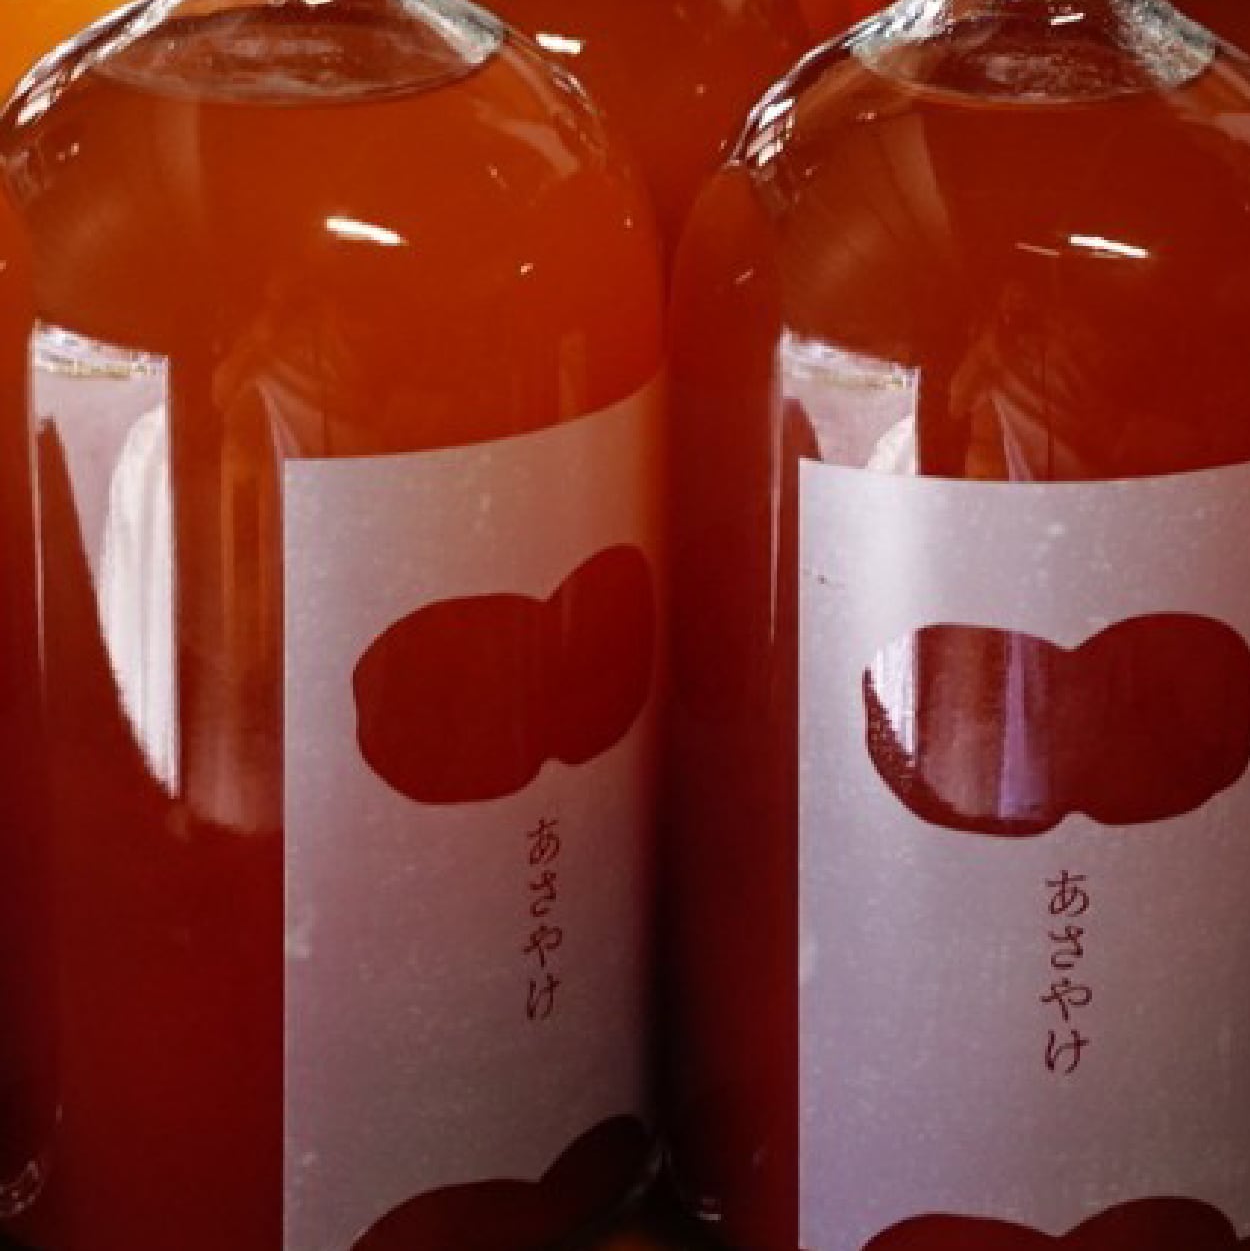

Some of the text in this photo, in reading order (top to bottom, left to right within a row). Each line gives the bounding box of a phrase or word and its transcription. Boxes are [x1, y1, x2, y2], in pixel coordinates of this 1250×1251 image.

[524, 818, 563, 1020] あさやけ
[1041, 869, 1092, 1074] あさやけ
